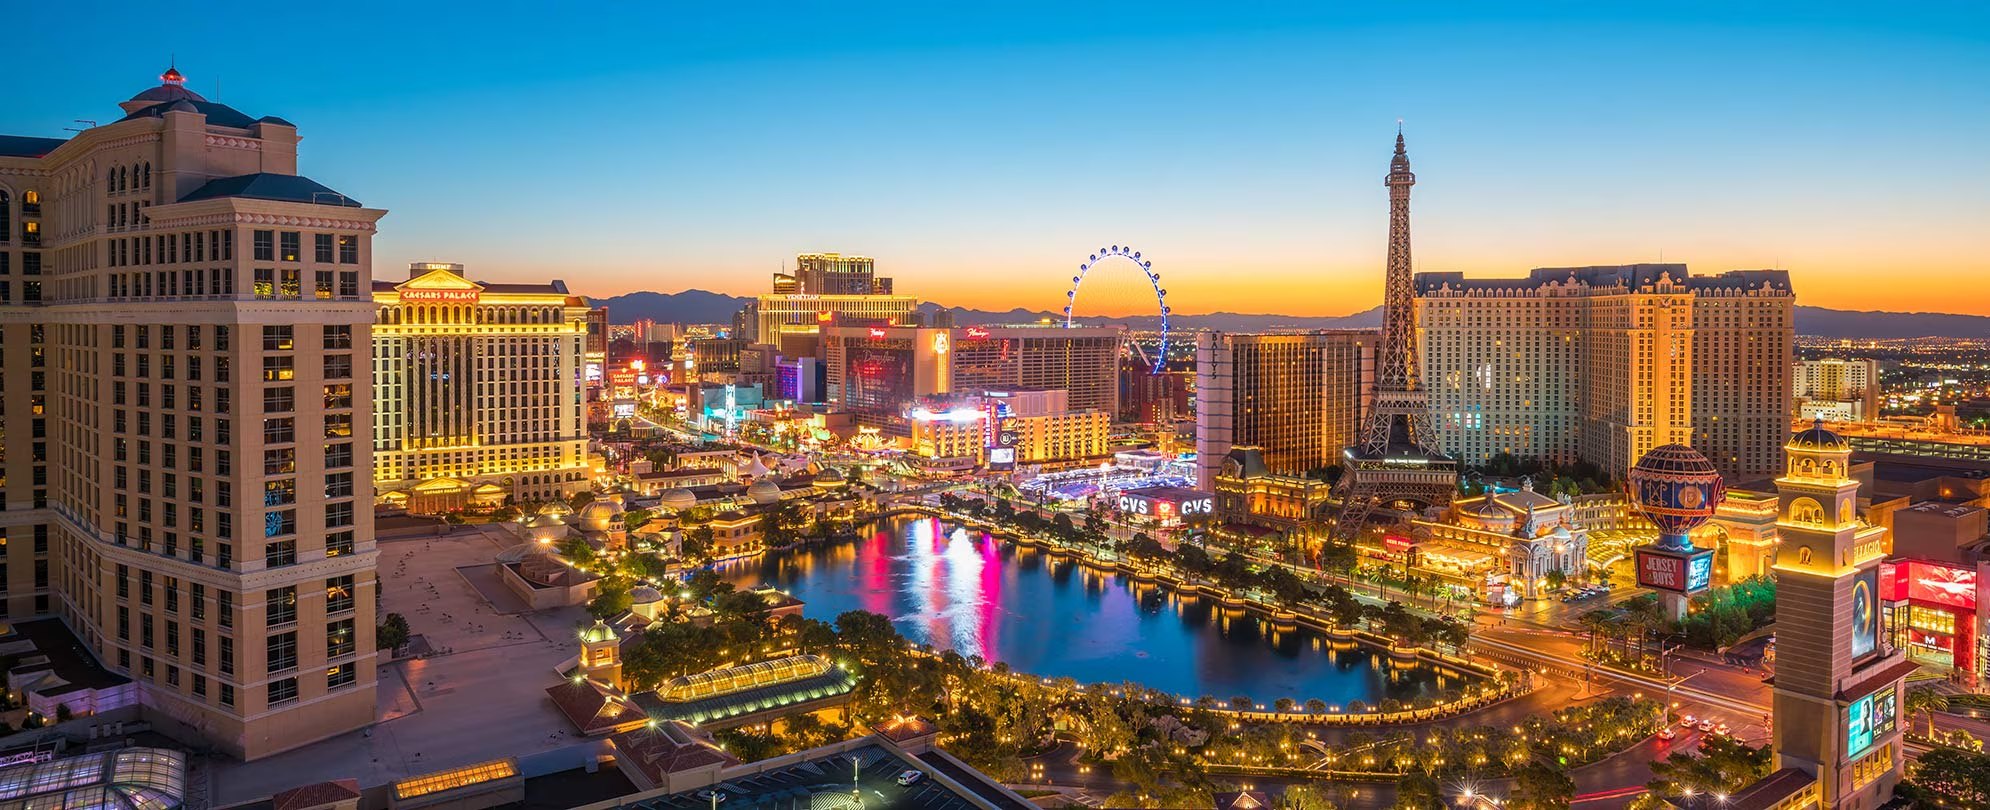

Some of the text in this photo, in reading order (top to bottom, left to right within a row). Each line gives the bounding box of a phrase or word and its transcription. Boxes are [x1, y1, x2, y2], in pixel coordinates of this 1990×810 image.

[403, 291, 477, 299] CAESARS PALACE
[1120, 496, 1148, 514] CVS
[1182, 498, 1212, 515] CVS
[1646, 557, 1677, 573] JERSEY
[1652, 571, 1675, 586] BOYS
[1925, 635, 1936, 645] M
